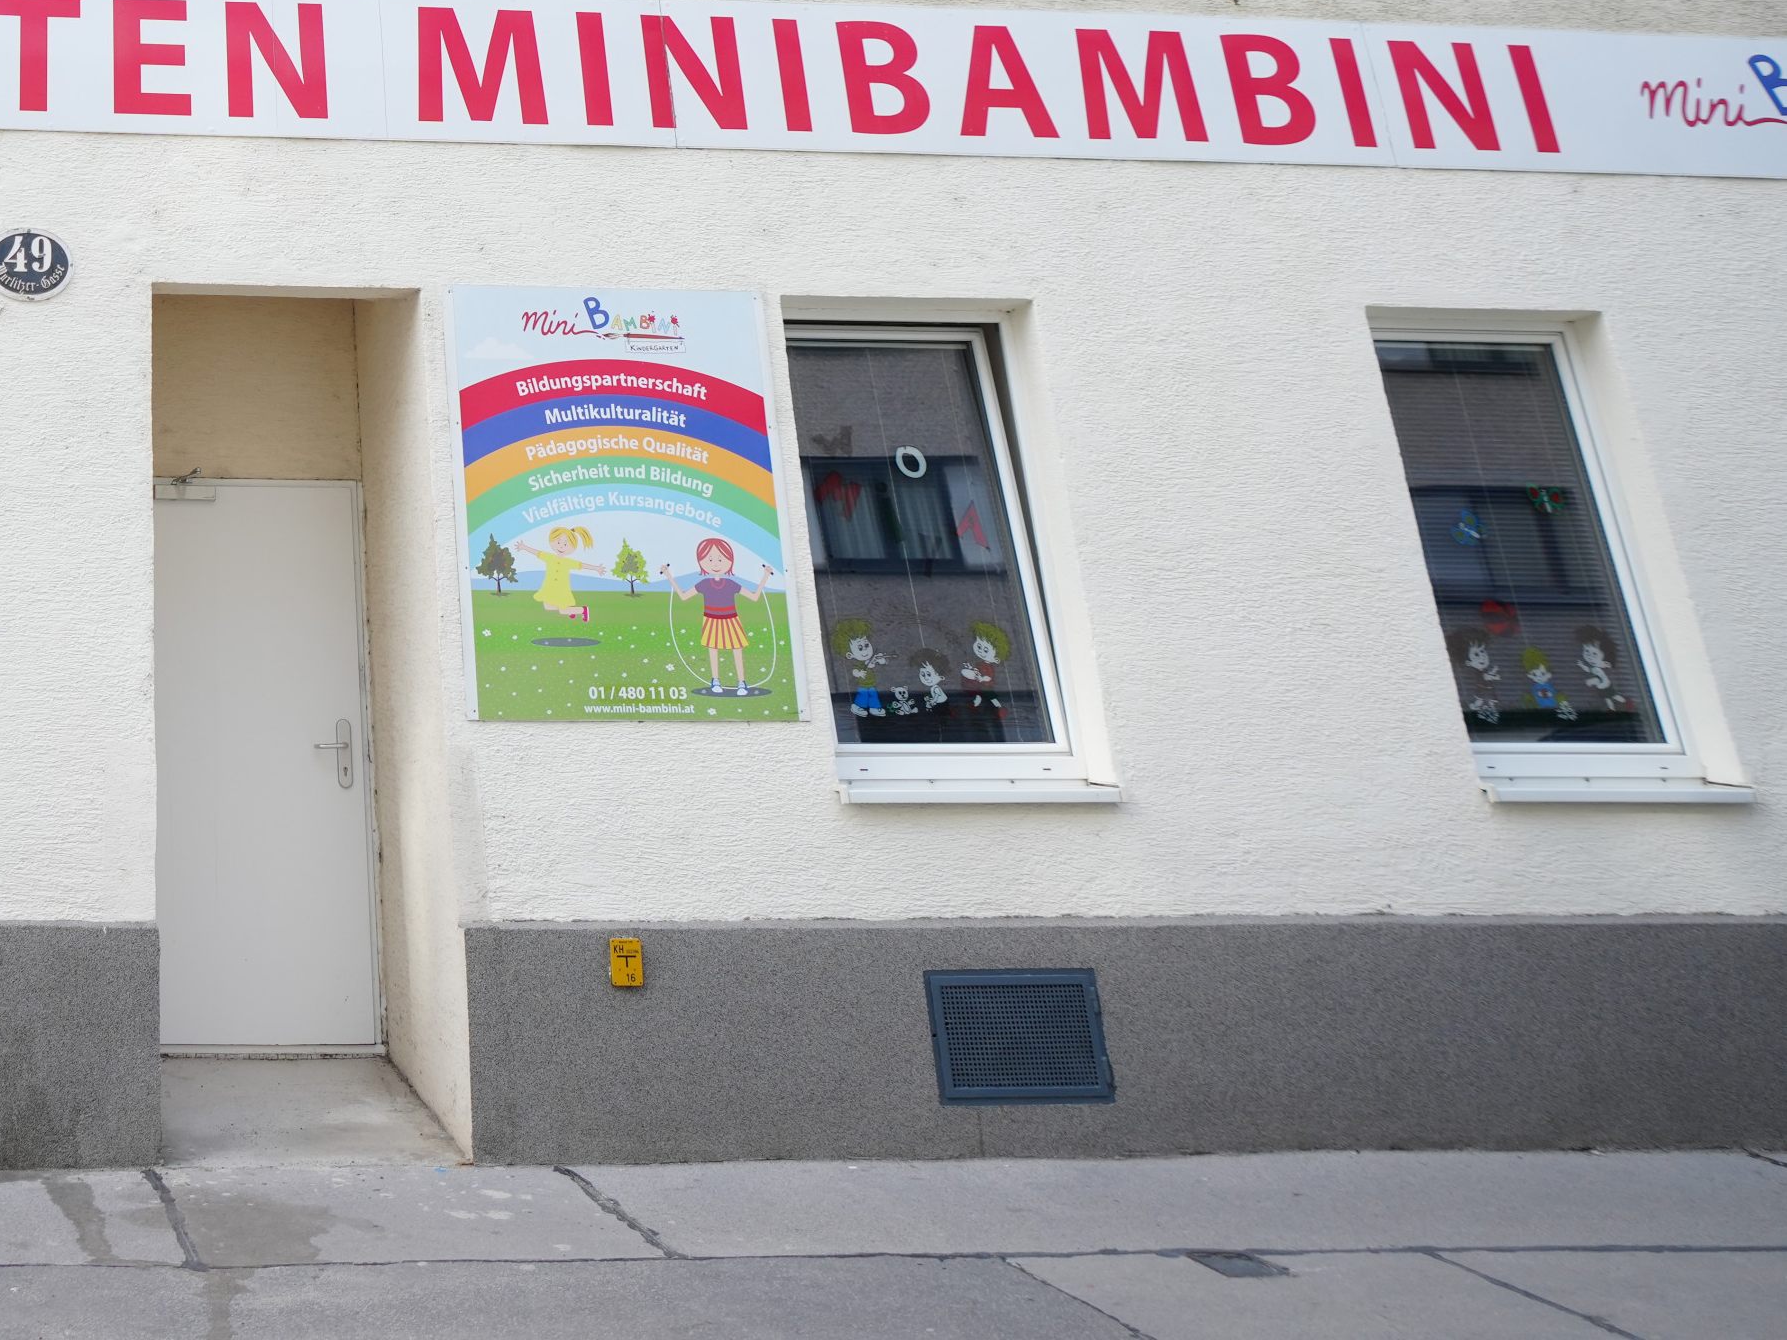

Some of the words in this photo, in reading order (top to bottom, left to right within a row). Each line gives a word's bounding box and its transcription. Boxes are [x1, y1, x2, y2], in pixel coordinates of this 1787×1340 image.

[417, 6, 1561, 153] MINIBAMBINI
[3, 235, 53, 272] 49
[516, 373, 708, 401] Bildungspartnerschaft
[544, 404, 687, 428] Multikulturalität
[525, 434, 639, 461] Pädagogische
[642, 437, 710, 465] Qualität
[528, 464, 611, 492] Sicherheit
[614, 465, 646, 480] und
[650, 466, 714, 498] Bildung
[522, 495, 605, 524] Vielfältige
[608, 492, 722, 528] Kursangebote
[589, 686, 605, 699] 01
[618, 686, 645, 699] 480
[648, 687, 665, 699] 11
[669, 687, 688, 700] 03
[584, 703, 695, 714] www.mini-bambini.at
[626, 973, 636, 982] 16
